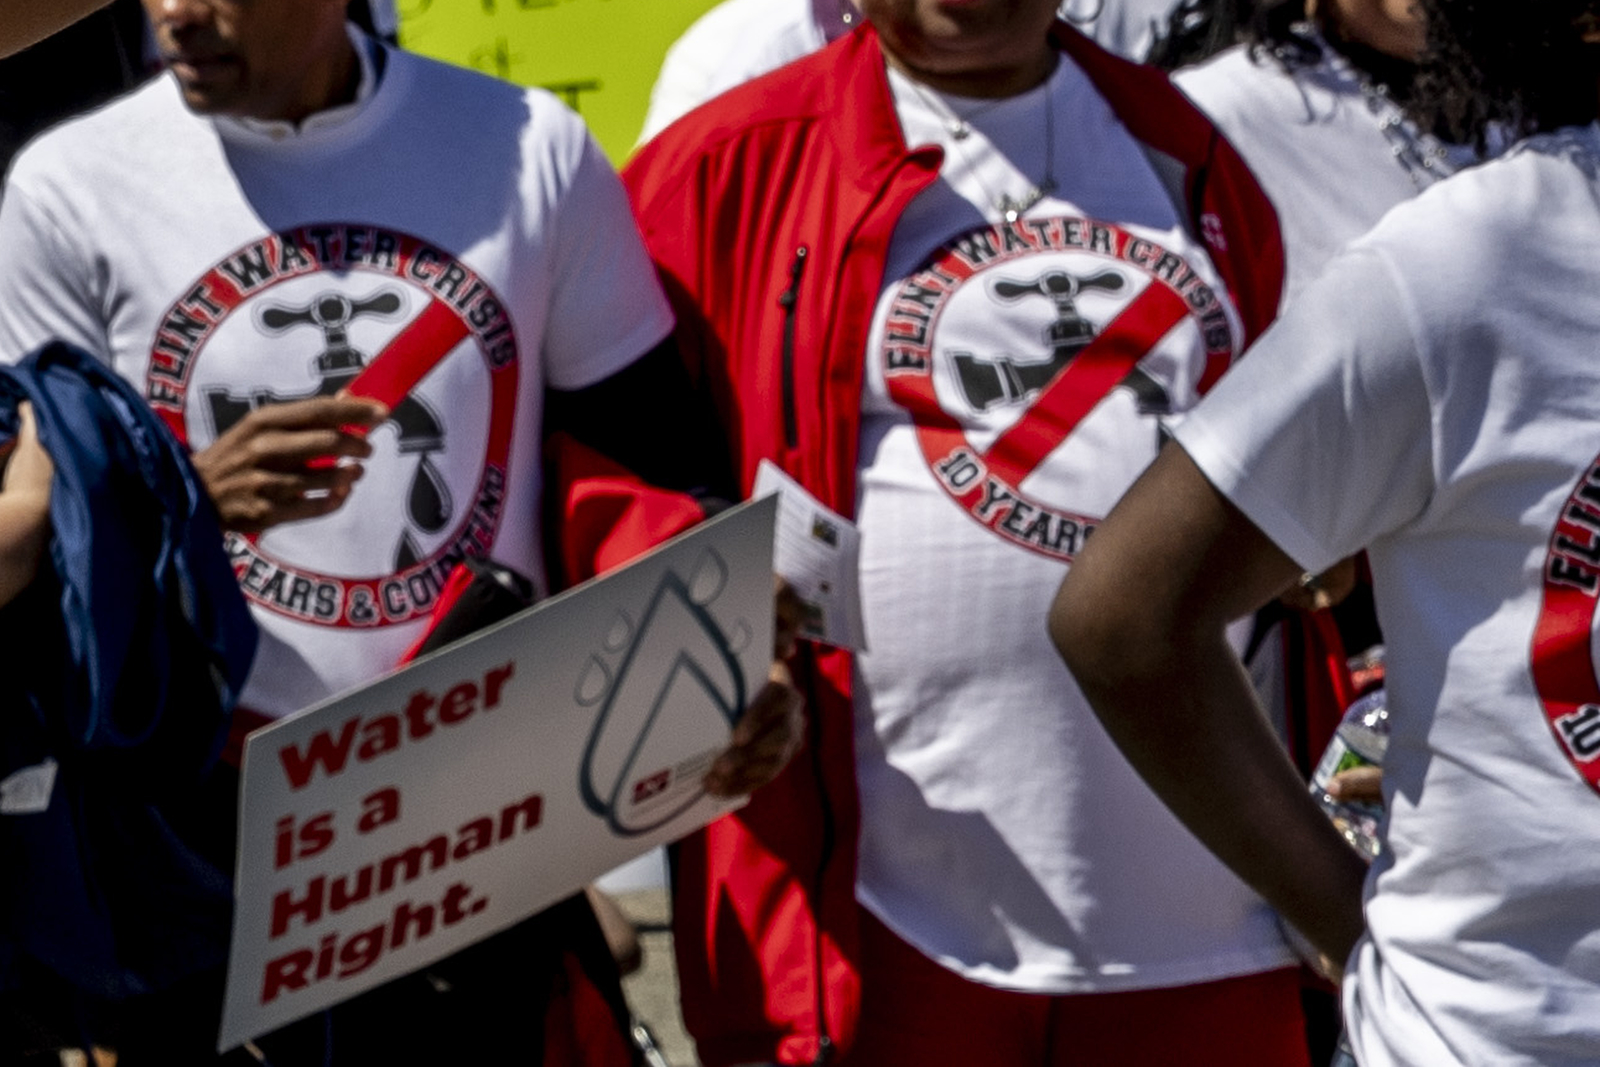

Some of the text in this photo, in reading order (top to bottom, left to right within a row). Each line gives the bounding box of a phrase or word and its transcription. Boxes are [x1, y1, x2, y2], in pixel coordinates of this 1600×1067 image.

[150, 232, 516, 406] FLINT WATER CRISIS
[887, 220, 1231, 375] FLINT WATER CRISIS
[938, 450, 1095, 556] 10 YEAR
[278, 658, 517, 791] Water
[267, 791, 546, 940] Human
[273, 784, 401, 870] is a
[258, 881, 489, 1006] Right.
